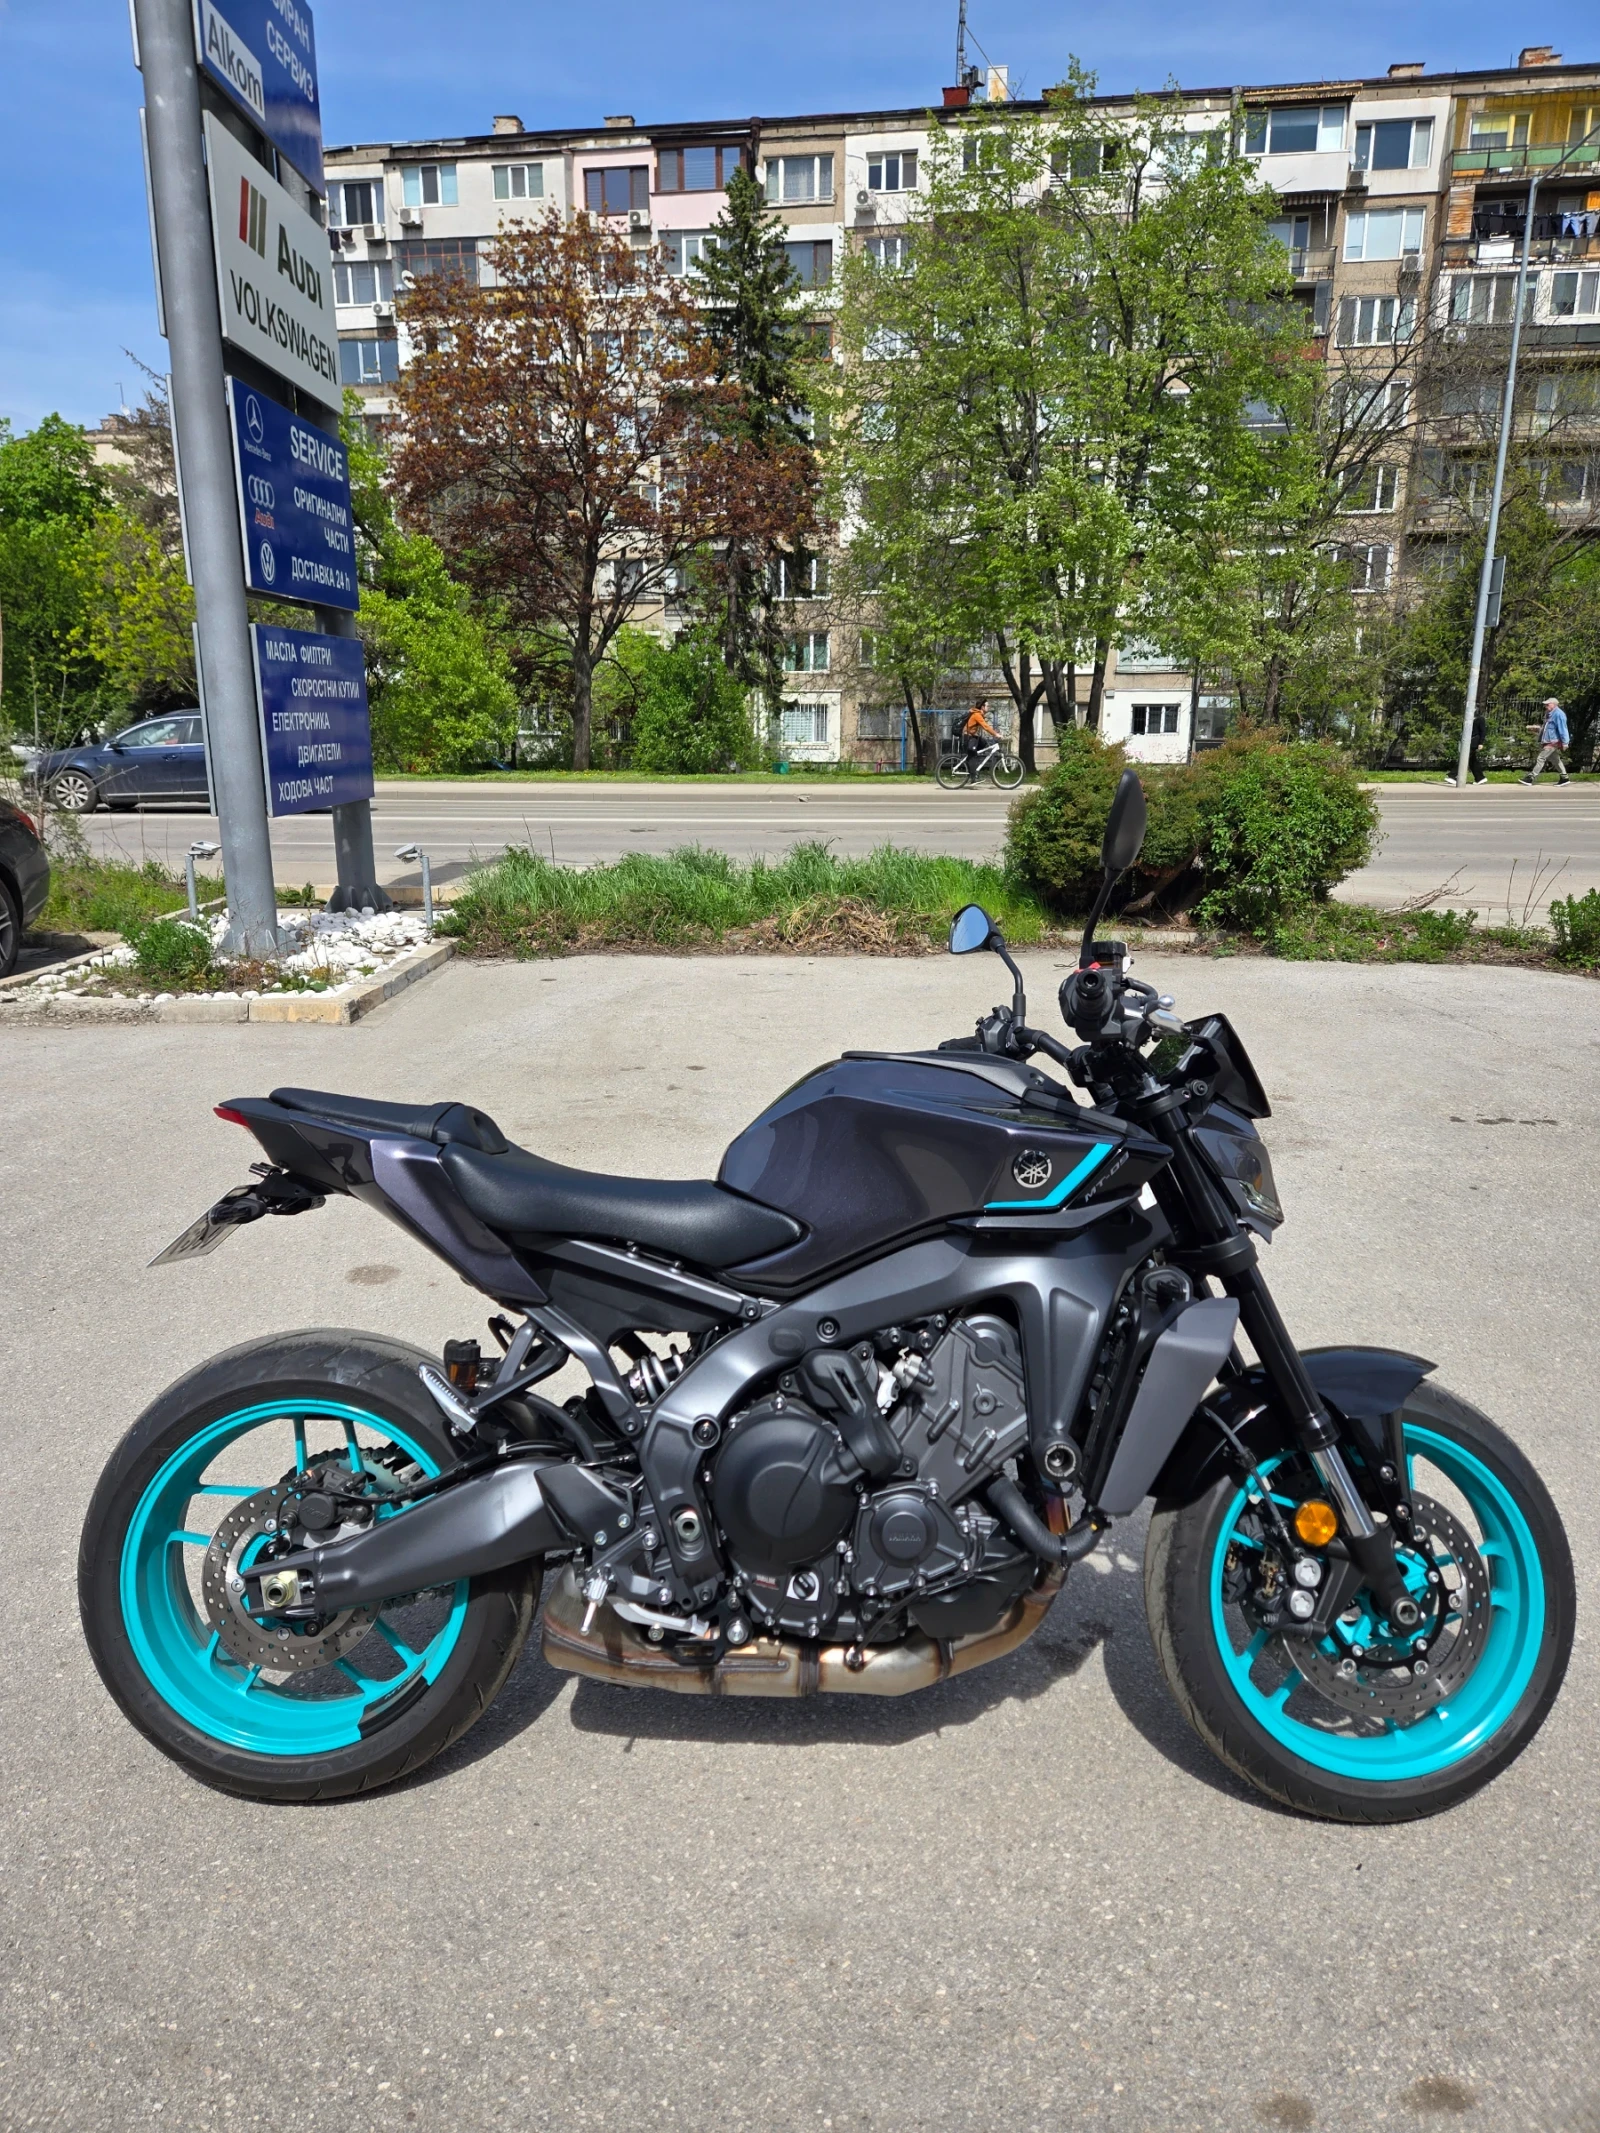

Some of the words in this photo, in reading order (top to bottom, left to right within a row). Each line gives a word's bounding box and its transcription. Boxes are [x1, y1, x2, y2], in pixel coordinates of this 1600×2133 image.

[208, 12, 263, 112] Alkom
[266, 20, 314, 103] СЕРВИЗ
[277, 223, 323, 310] AUDI
[230, 268, 337, 386] VOLKSWAGEN
[290, 425, 343, 482] SERVICE
[254, 507, 275, 529] Audi
[293, 486, 347, 527] ОРИГИНАЛНИ
[324, 527, 350, 554] ЧАСТИ
[291, 556, 335, 587] ДОСТАВКА
[335, 569, 345, 590] 24
[345, 573, 351, 591] h
[265, 640, 298, 662] МАСЛА
[300, 645, 332, 666] ФИЛТРИ
[291, 678, 338, 698] СКОРОСТНИ
[338, 681, 360, 698] КУТИИ
[272, 712, 331, 732] ЕЛЕКТРОНИКА
[297, 742, 342, 768] ДВИГАТЕЛИ
[278, 779, 314, 803] ХОДОВА
[314, 775, 334, 795] ЧАСТ
[1084, 1151, 1129, 1203] MT-09
